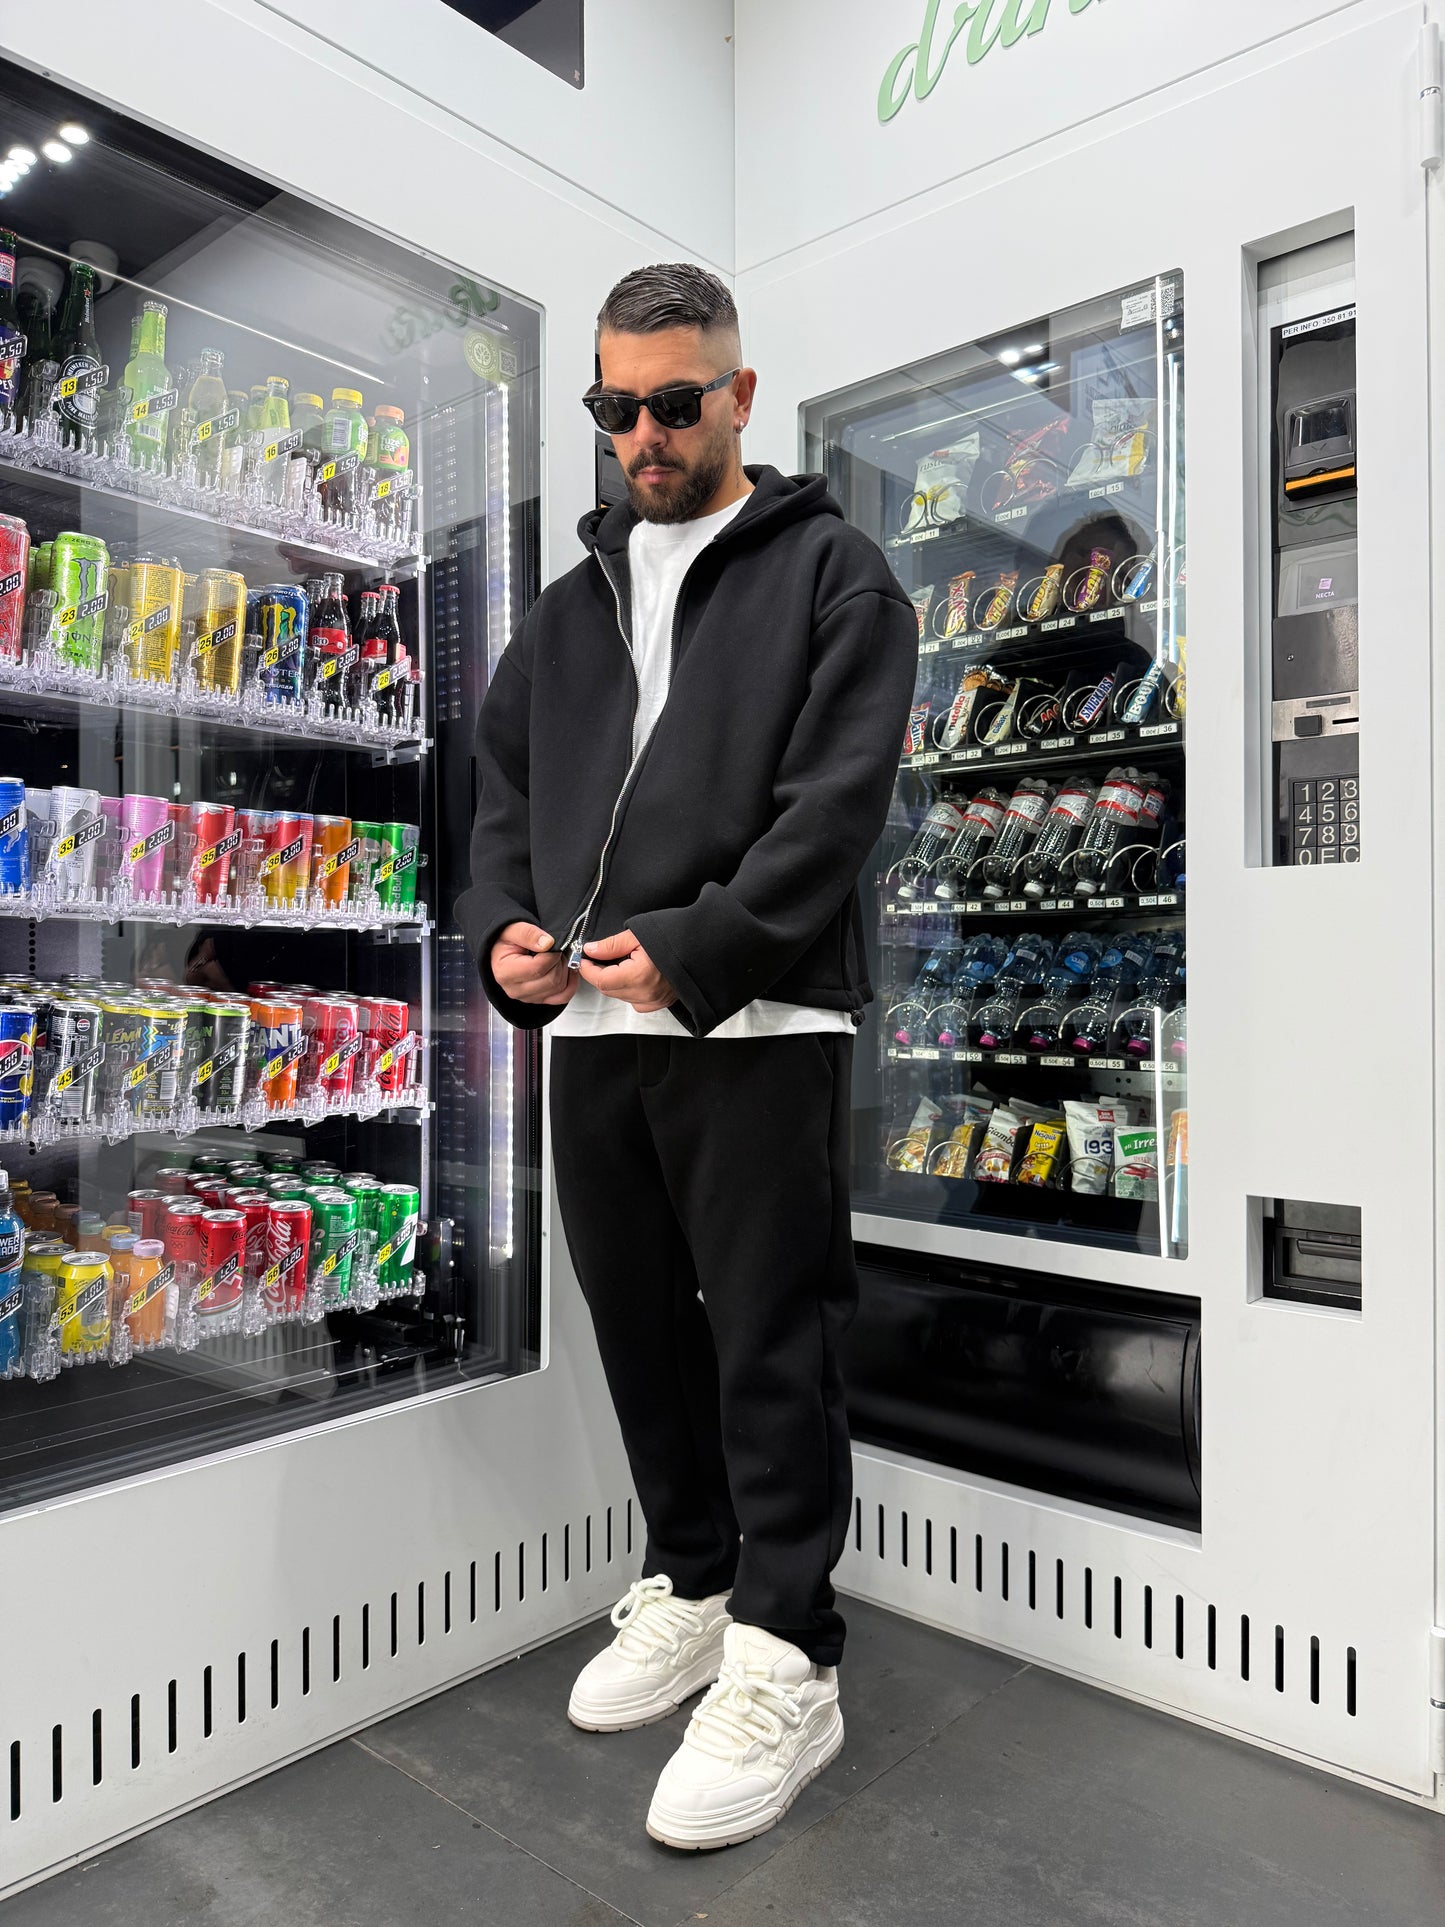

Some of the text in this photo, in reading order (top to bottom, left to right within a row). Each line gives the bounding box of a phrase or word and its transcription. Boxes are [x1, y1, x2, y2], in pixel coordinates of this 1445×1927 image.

[1283, 326, 1298, 336] PER
[1322, 315, 1336, 325] 350
[1348, 309, 1357, 317] 91
[63, 371, 103, 393] 13 1.50
[135, 395, 173, 417] 14 1.50
[200, 414, 234, 436] 15 1.50
[266, 435, 299, 457] 16 1.50
[324, 456, 356, 477] 17 1.50
[379, 482, 389, 493] 18
[1315, 591, 1335, 599] NECTA
[61, 597, 103, 623] 23 2.00
[1111, 609, 1121, 617] 25
[131, 608, 168, 638] 24 2.00
[199, 624, 234, 650] 25 2.00
[312, 637, 329, 646] Bro
[266, 638, 299, 663] 26 2.00
[324, 650, 356, 675] 27 2.00
[1081, 678, 1113, 720] SNICKERS
[948, 695, 966, 731] nutella
[911, 711, 926, 748] Daim
[1301, 780, 1357, 801] 1 2 3
[0, 812, 16, 834] .00
[1298, 802, 1357, 823] 4 5 6
[60, 823, 101, 854] 33 2.00
[131, 827, 170, 858] 34 2.00
[1298, 824, 1357, 845] 7 8 9
[201, 833, 238, 864] 35 2.00
[268, 841, 301, 869] 36 2.00
[326, 842, 358, 874] 37 2.00
[1299, 846, 1359, 865] 0 C
[382, 853, 413, 878] 38 2.00
[0, 1051, 18, 1075] .00
[132, 1046, 171, 1081] 44 1.20
[270, 1043, 303, 1072] 46 1.20
[328, 1039, 359, 1069] 47 1.20
[1013, 1055, 1024, 1063] 53
[1062, 1058, 1071, 1066] 54
[59, 1051, 99, 1085] 43 1.20
[199, 1062, 212, 1079] 45
[1034, 1130, 1056, 1142] Nesquik
[199, 1280, 211, 1296] 55
[220, 1256, 236, 1279] 1.20
[267, 1269, 279, 1283] 56
[325, 1258, 335, 1271] 57
[60, 1279, 102, 1320] 53 1.00
[133, 1268, 171, 1307] 54 1.00
